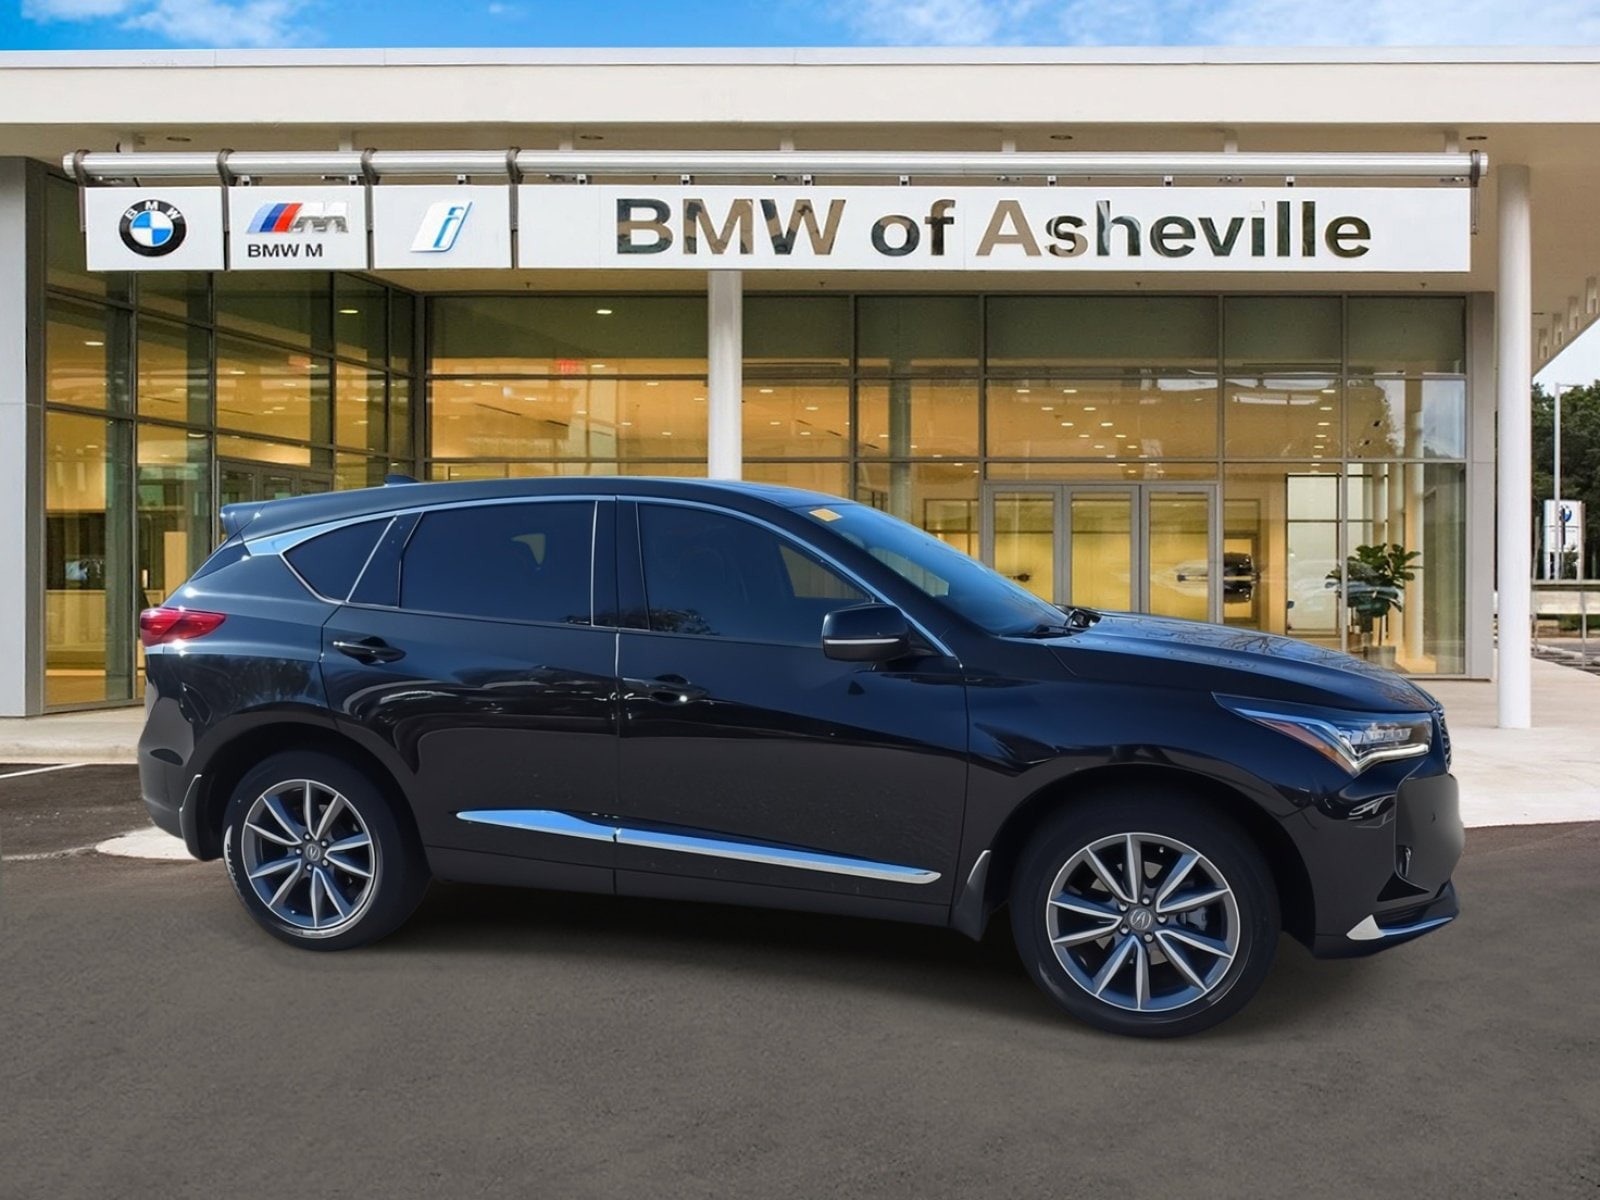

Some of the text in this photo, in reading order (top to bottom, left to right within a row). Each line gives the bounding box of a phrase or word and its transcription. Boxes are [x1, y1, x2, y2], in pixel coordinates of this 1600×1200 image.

[124, 200, 181, 220] BMW
[616, 198, 1371, 259] BMW of Asheville
[247, 243, 323, 258] BMW M
